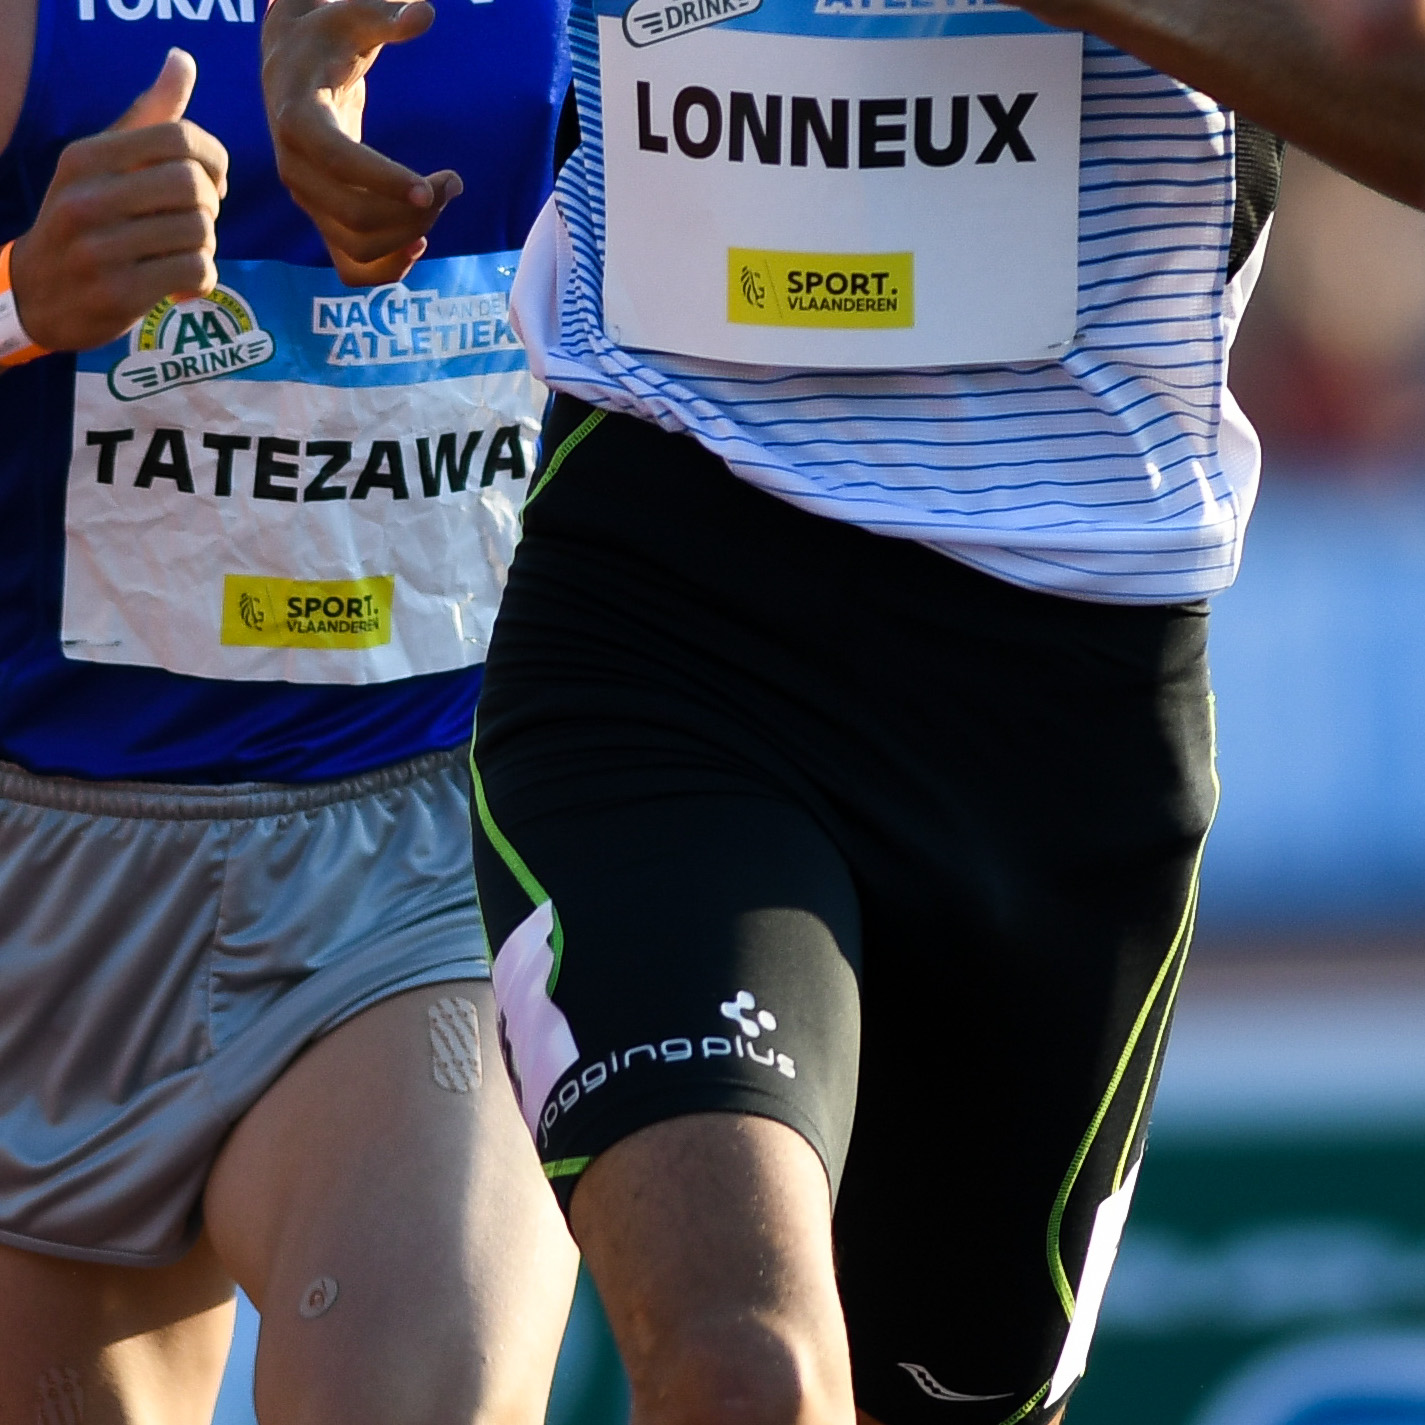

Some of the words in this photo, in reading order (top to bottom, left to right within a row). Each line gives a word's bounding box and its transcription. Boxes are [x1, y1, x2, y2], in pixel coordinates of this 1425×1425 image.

[636, 80, 1039, 169] LONNEUX
[319, 288, 432, 336] NACHT
[786, 296, 898, 312] VLAANDEREN
[172, 311, 233, 356] AA
[161, 344, 247, 383] DRINK
[85, 424, 527, 503] TATEZAWA
[287, 619, 379, 634] VLAANDEREN
